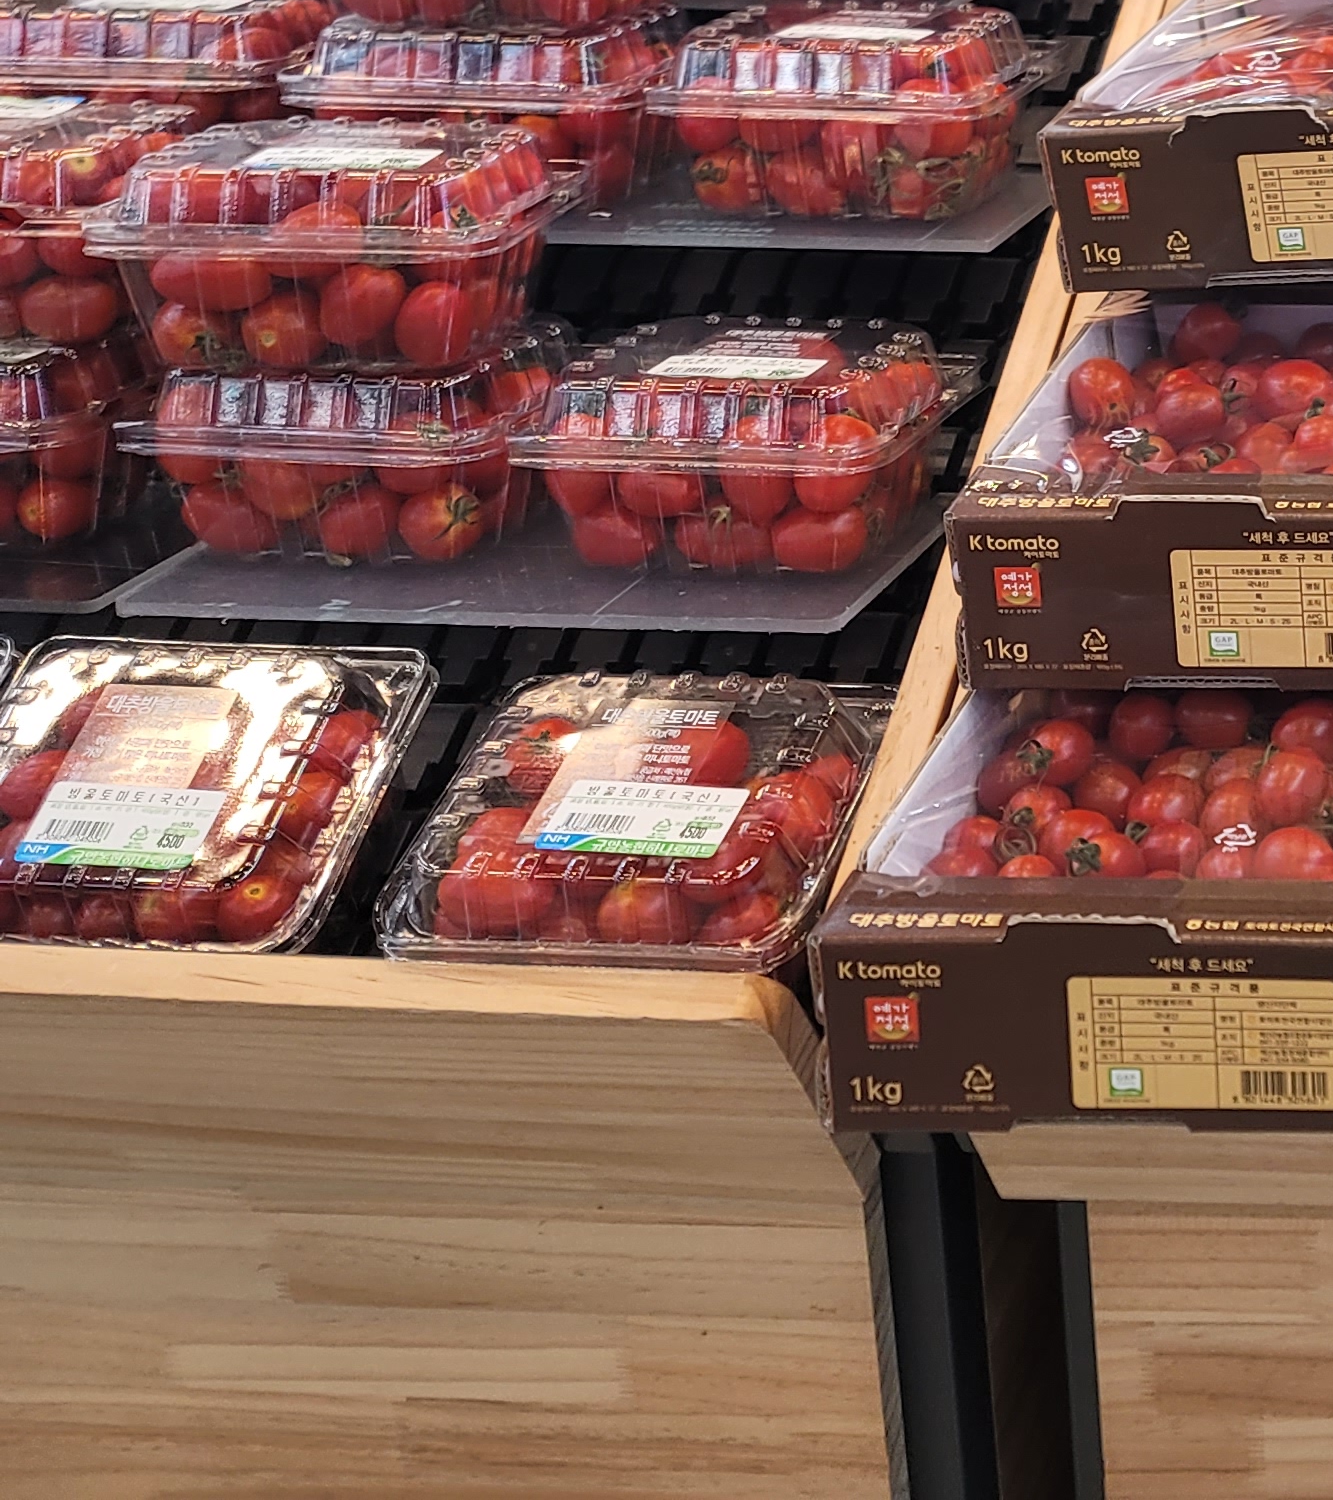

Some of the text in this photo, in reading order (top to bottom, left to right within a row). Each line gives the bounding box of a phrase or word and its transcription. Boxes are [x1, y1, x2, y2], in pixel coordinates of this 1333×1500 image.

[1061, 147, 1140, 164] K tomato
[1081, 243, 1121, 265] 1kg
[969, 535, 1059, 551] K tomato
[1277, 532, 1290, 544] 후
[983, 637, 1028, 662] 1kg
[544, 834, 570, 843] NH
[24, 843, 50, 855] NH
[837, 960, 941, 980] K tomato
[850, 1076, 902, 1105] 1kg
